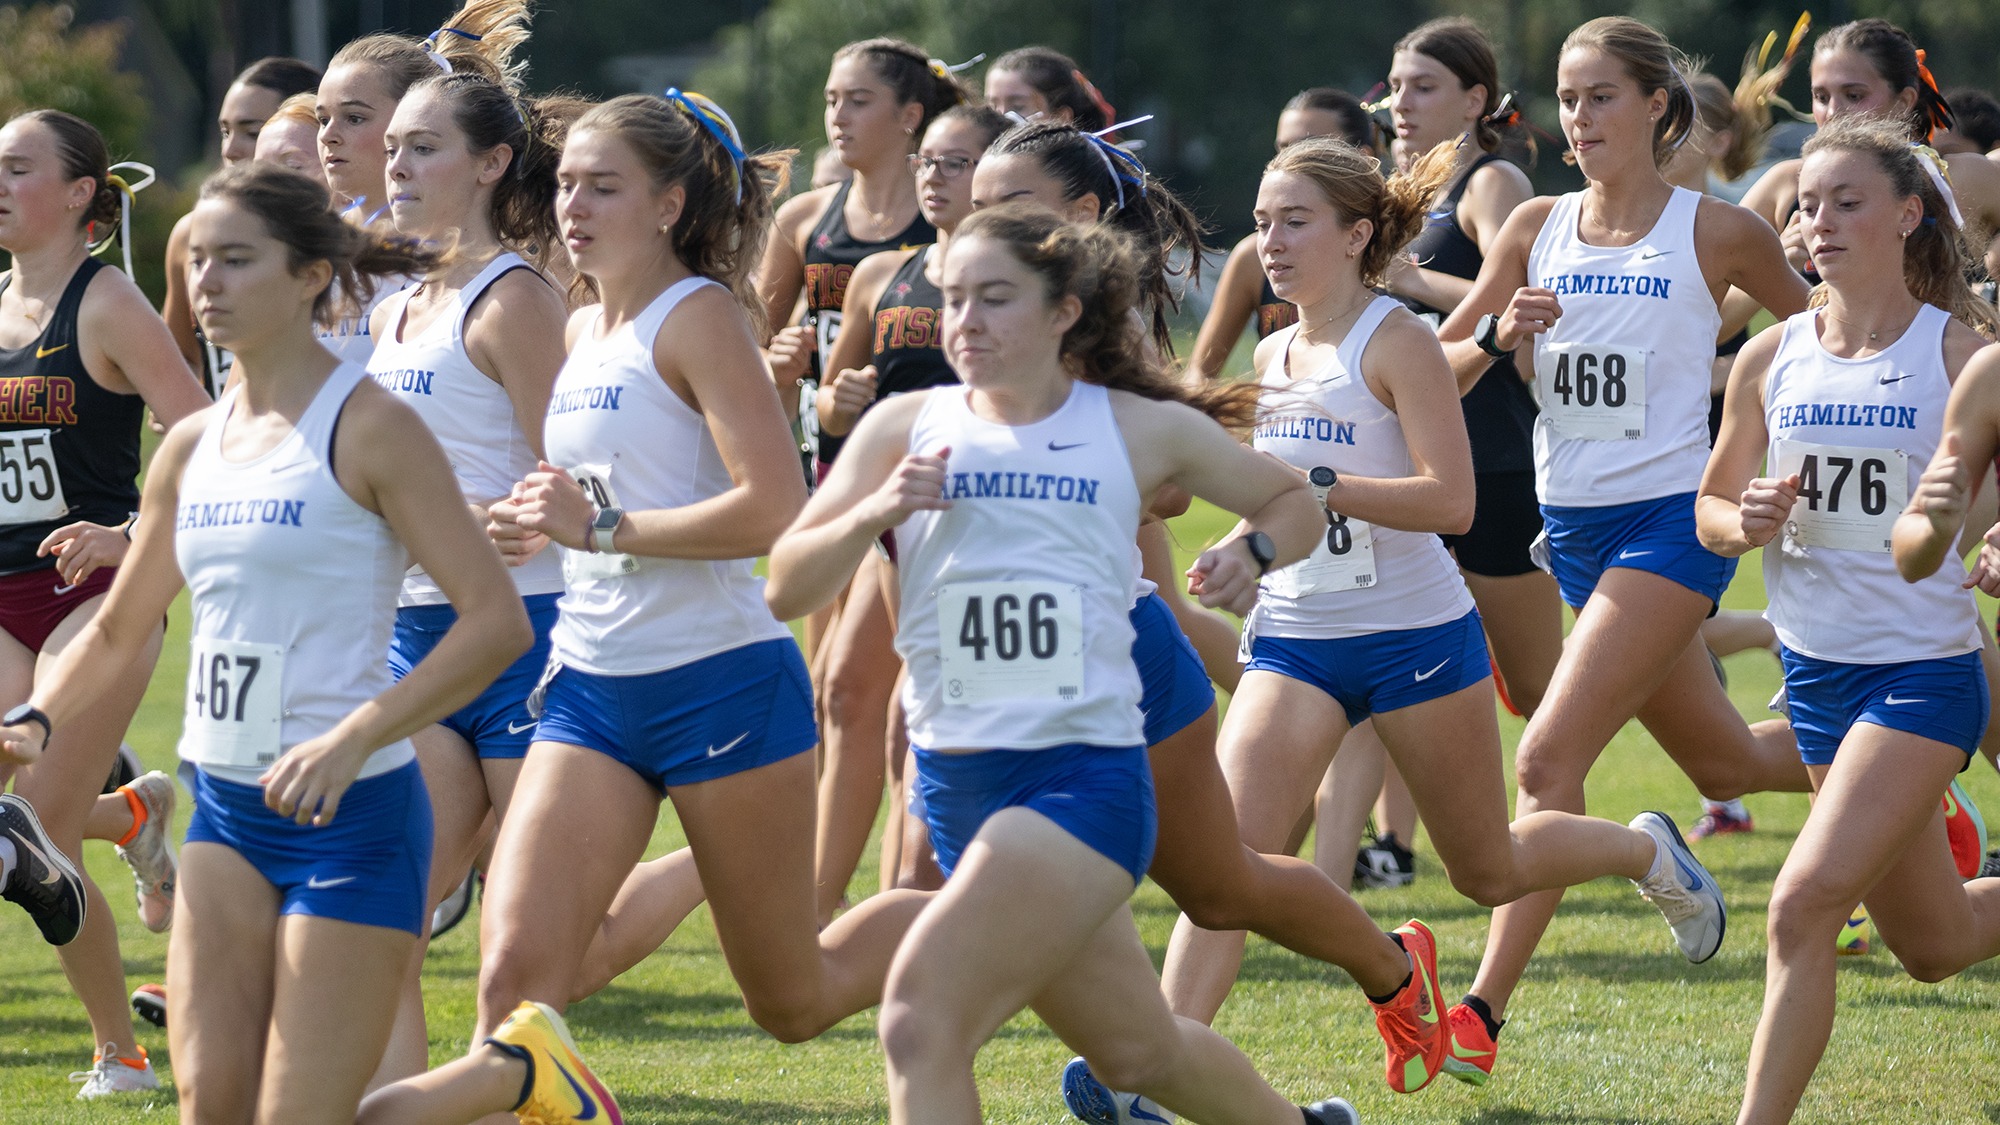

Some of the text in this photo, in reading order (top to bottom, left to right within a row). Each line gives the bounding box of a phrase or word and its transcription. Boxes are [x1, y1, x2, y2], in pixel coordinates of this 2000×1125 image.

[1554, 353, 1627, 408] 468
[1780, 404, 1917, 429] HAMILTON
[1797, 454, 1887, 516] 476
[959, 592, 1059, 661] 466
[195, 652, 261, 722] 467
